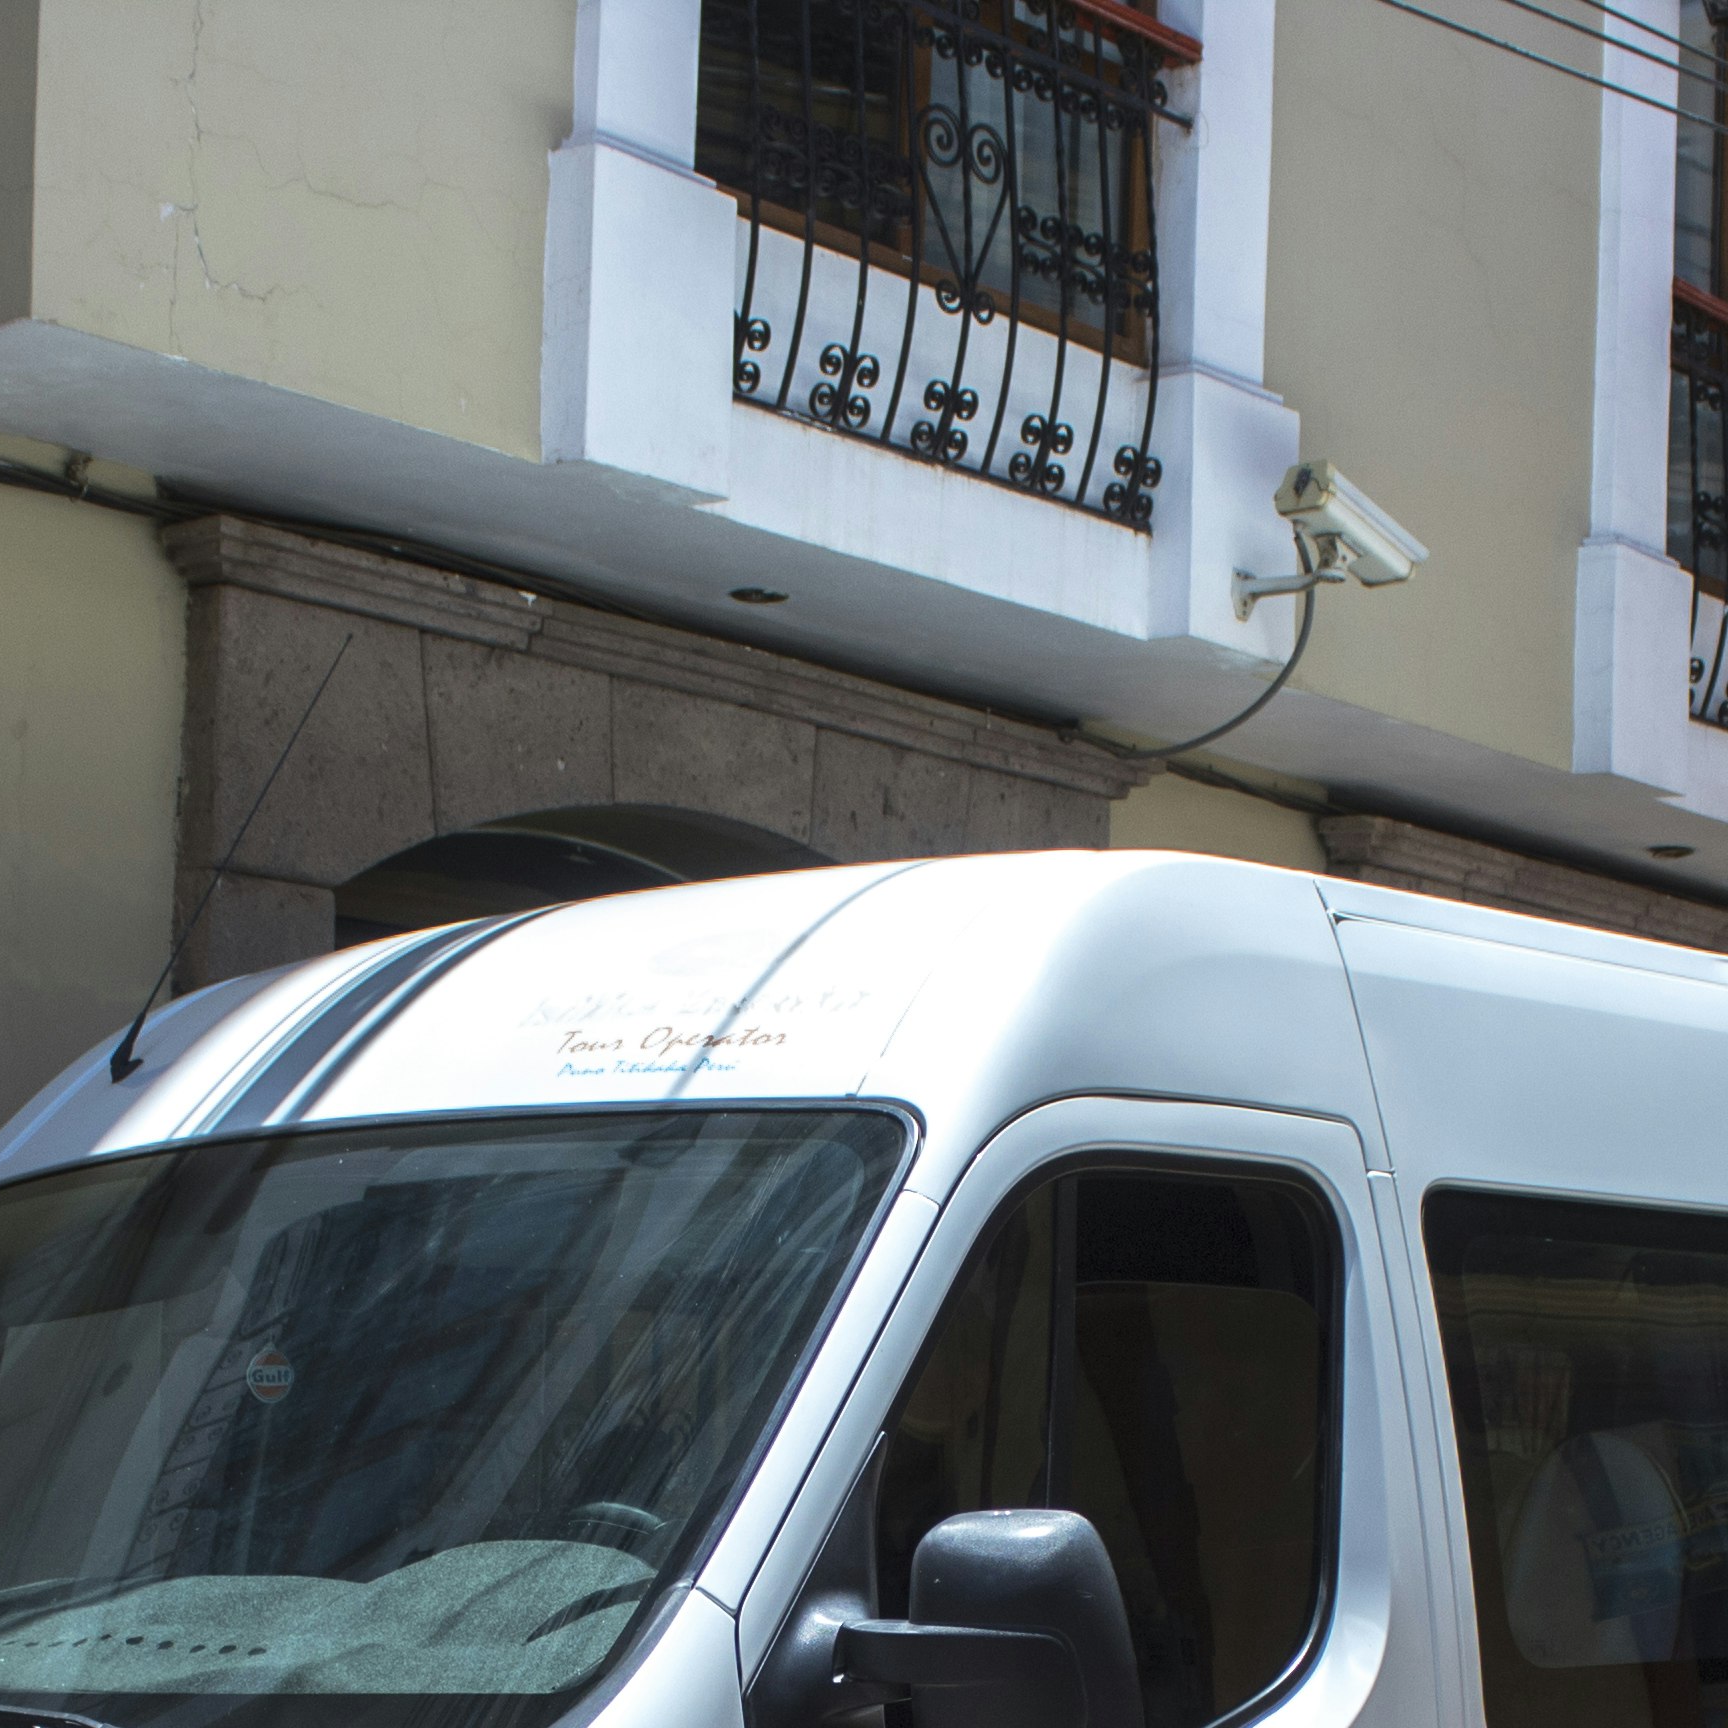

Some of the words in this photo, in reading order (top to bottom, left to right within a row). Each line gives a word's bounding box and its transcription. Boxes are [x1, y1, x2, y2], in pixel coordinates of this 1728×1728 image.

[556, 1030, 624, 1055] Tour
[639, 1025, 787, 1058] Operator
[251, 1369, 290, 1383] Gulf
